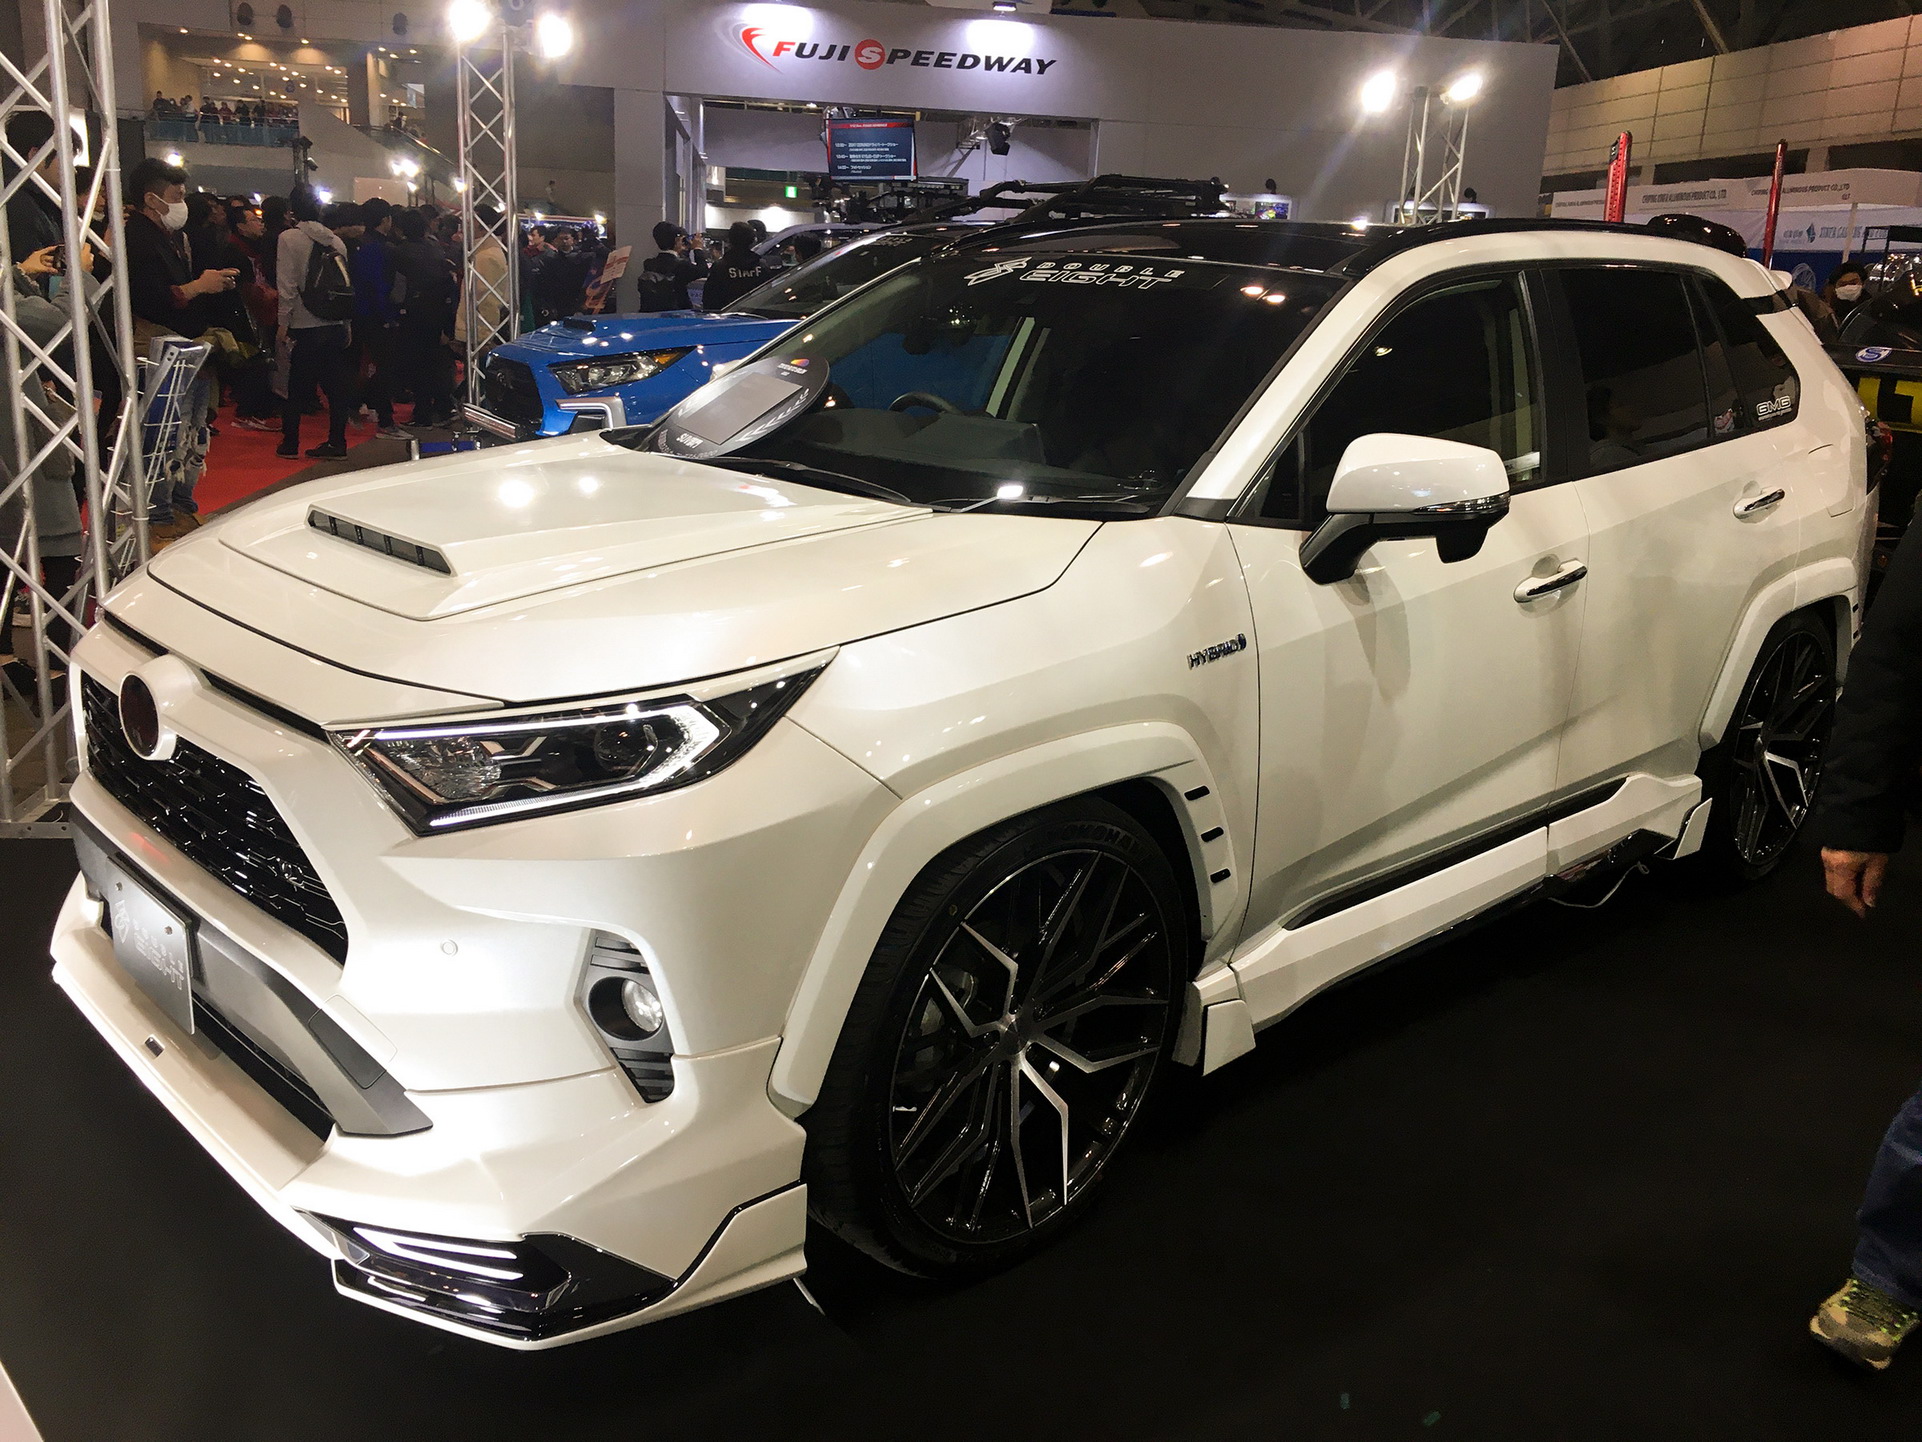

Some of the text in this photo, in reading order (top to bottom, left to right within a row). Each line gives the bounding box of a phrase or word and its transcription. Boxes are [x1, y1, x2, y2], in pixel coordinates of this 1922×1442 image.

[1019, 269, 1173, 290] EIGHT
[1036, 261, 1185, 278] DOUBLE
[1187, 639, 1239, 670] HYBRID
